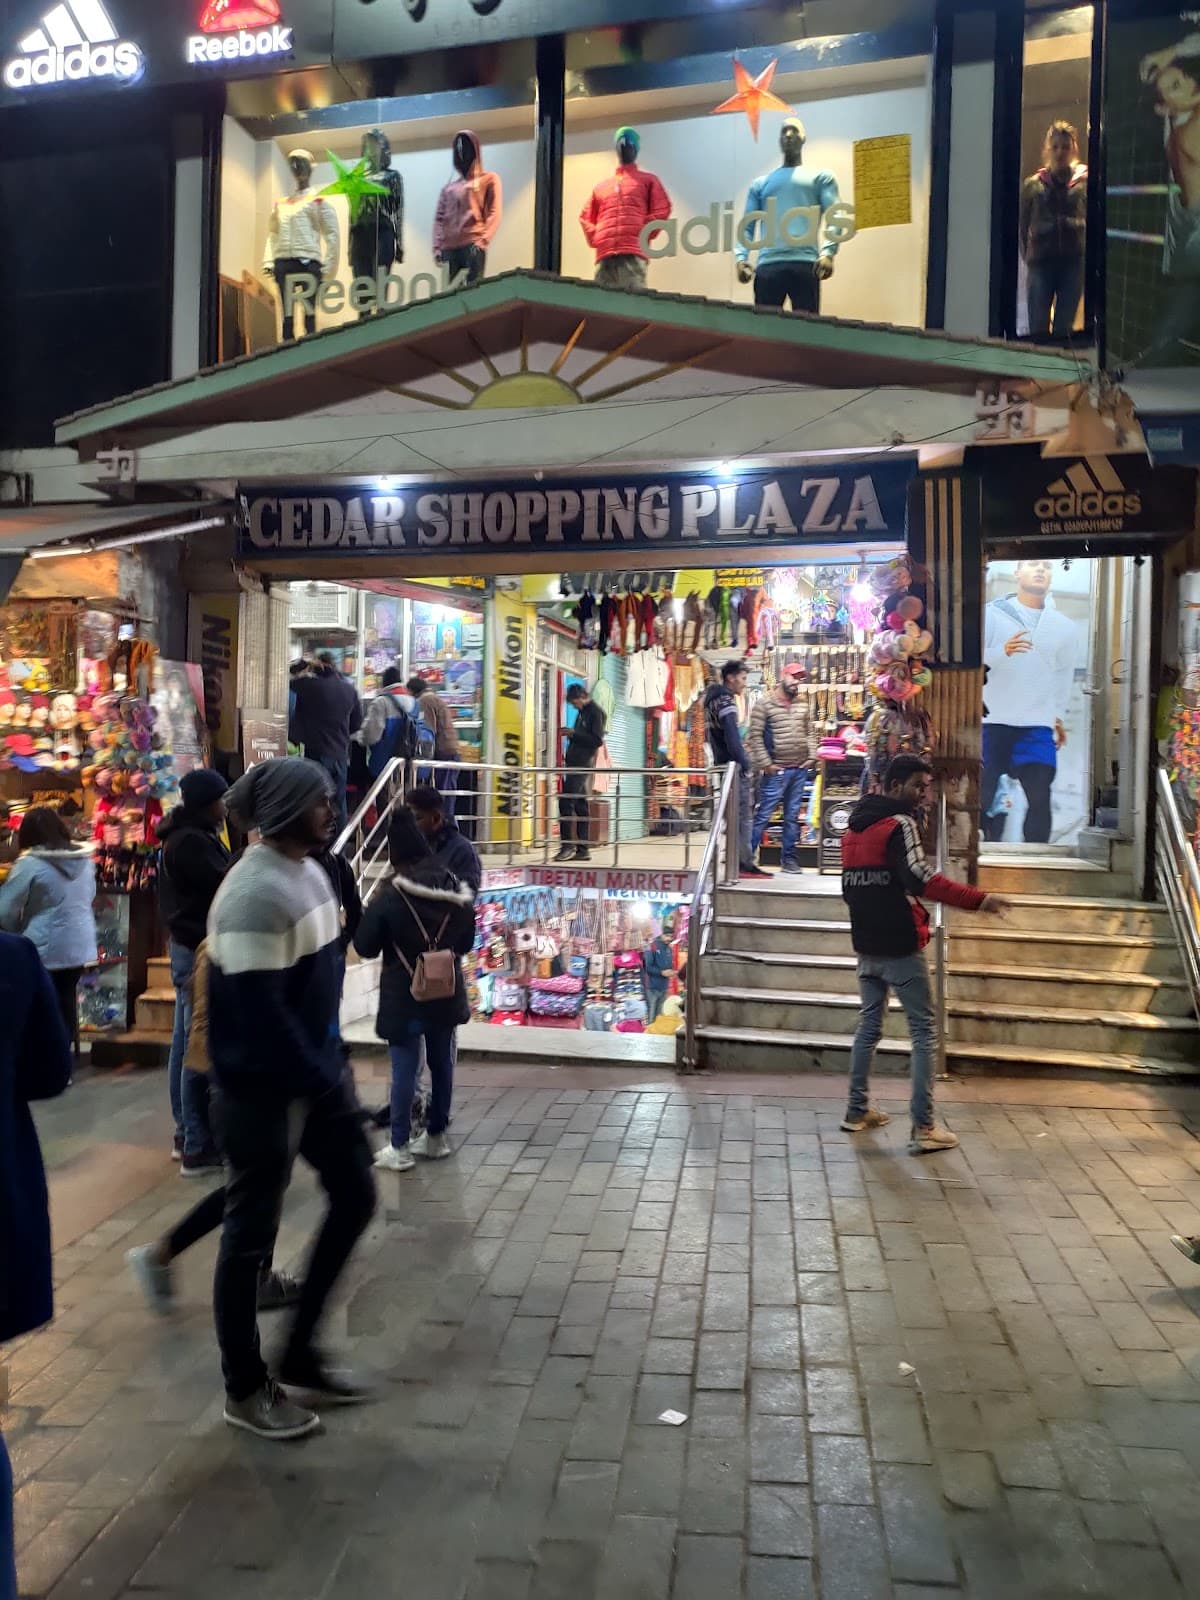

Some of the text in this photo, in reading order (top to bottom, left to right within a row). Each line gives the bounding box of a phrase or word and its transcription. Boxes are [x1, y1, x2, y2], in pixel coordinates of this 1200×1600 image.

[4, 40, 141, 89] adidas
[186, 26, 293, 64] Reebok
[638, 196, 858, 259] adidas
[283, 261, 470, 317] Reebok
[250, 475, 889, 548] CEDAR SHOPPING PLAZA
[1033, 490, 1142, 519] adidas
[499, 615, 523, 701] Nikon
[529, 868, 689, 892] TIBETAN MARKET
